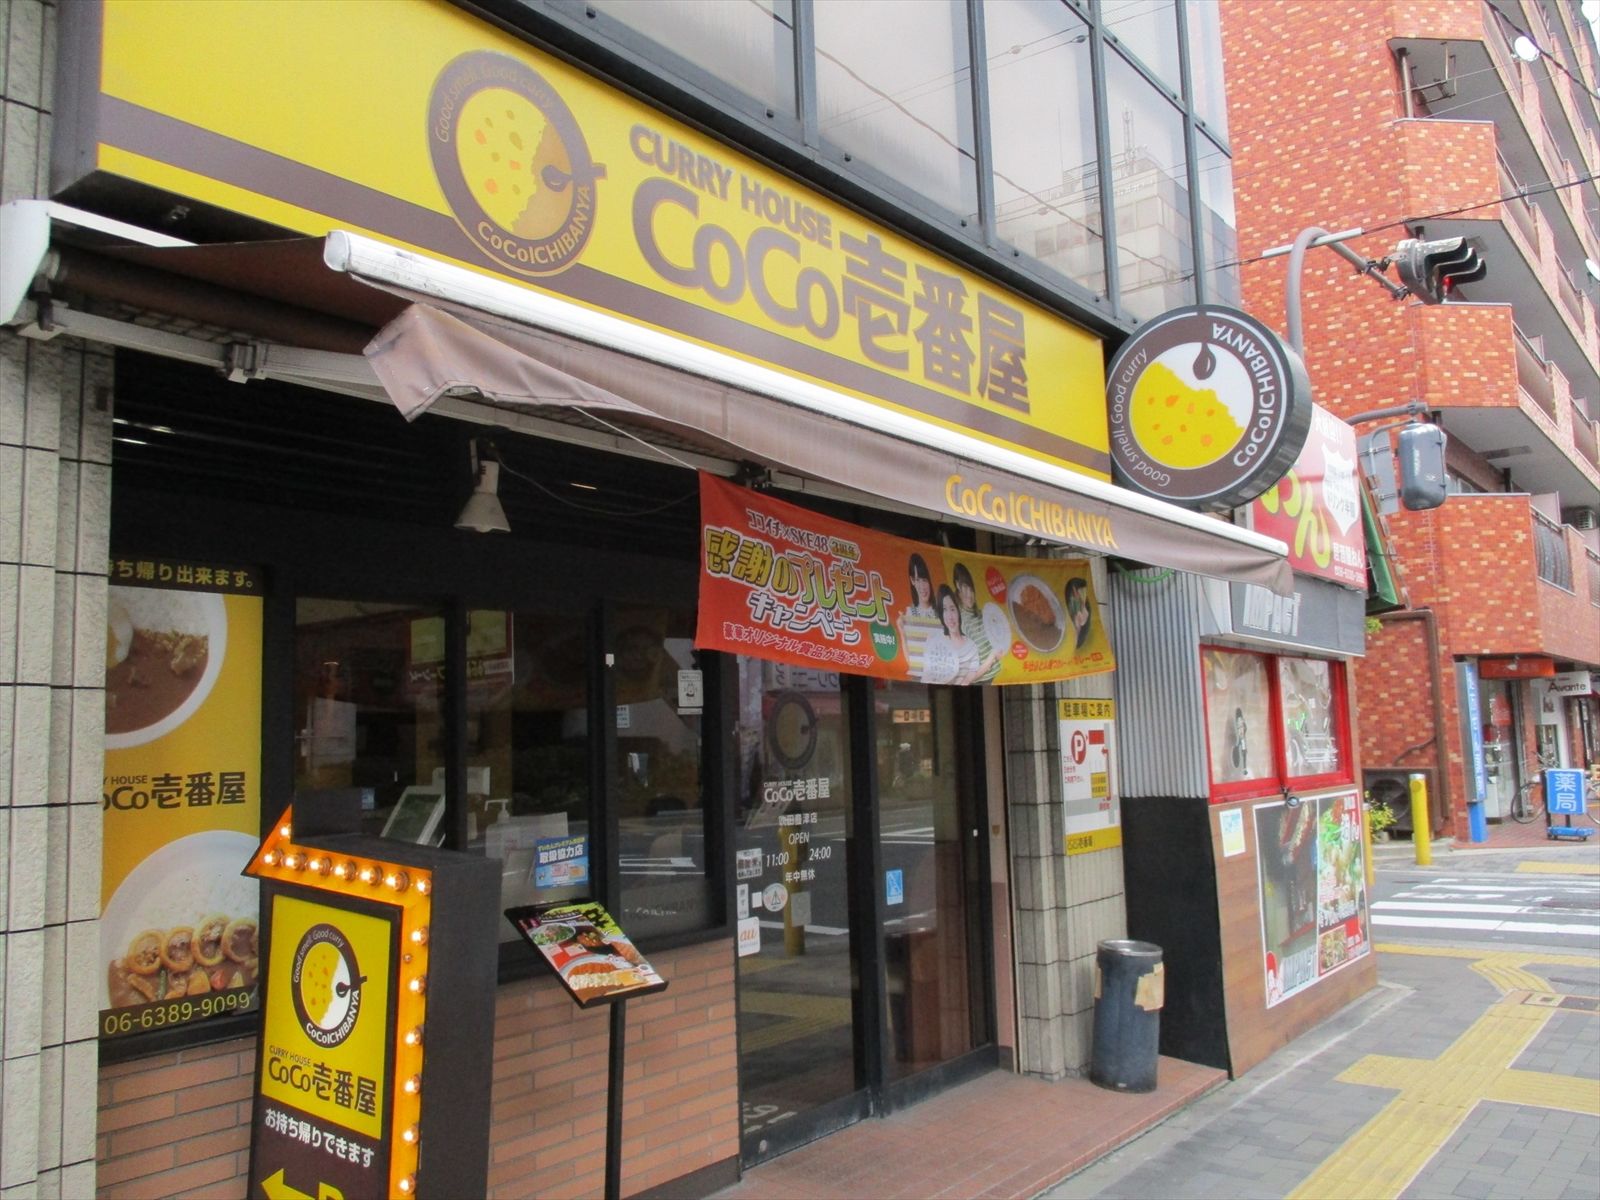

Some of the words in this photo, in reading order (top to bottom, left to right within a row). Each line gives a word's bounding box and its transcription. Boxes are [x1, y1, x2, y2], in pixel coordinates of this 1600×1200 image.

[435, 93, 455, 143] Good
[629, 123, 734, 201] CURRY
[741, 175, 833, 250] HOUSE
[632, 177, 1031, 415] CoCo壱番屋
[1122, 348, 1147, 383] curry
[1111, 384, 1127, 425] Good
[1212, 322, 1275, 467] CoCoICHIBANYA
[1113, 425, 1139, 463] smell.
[1134, 461, 1171, 487] Good
[704, 524, 894, 626] 感謝のプレゼント
[748, 591, 861, 646] キャンペーン
[1548, 681, 1587, 693] Avante
[111, 775, 147, 785] HOUSE
[764, 778, 830, 803] CoCo壱番屋
[1554, 772, 1577, 812] 薬局
[766, 852, 789, 867] 11:00
[809, 846, 832, 861] 24:00
[788, 832, 810, 846] OPEN
[785, 869, 816, 883] 年中無休
[741, 929, 756, 941] au
[104, 992, 250, 1035] 06-6389-9099
[306, 990, 360, 1044] CoCoICHIBANYA
[269, 1044, 289, 1059] CURRY
[290, 1051, 311, 1067] HOUSE
[268, 1056, 377, 1118] CoCo壱番屋
[265, 1108, 375, 1168] お持ち帰りできます
